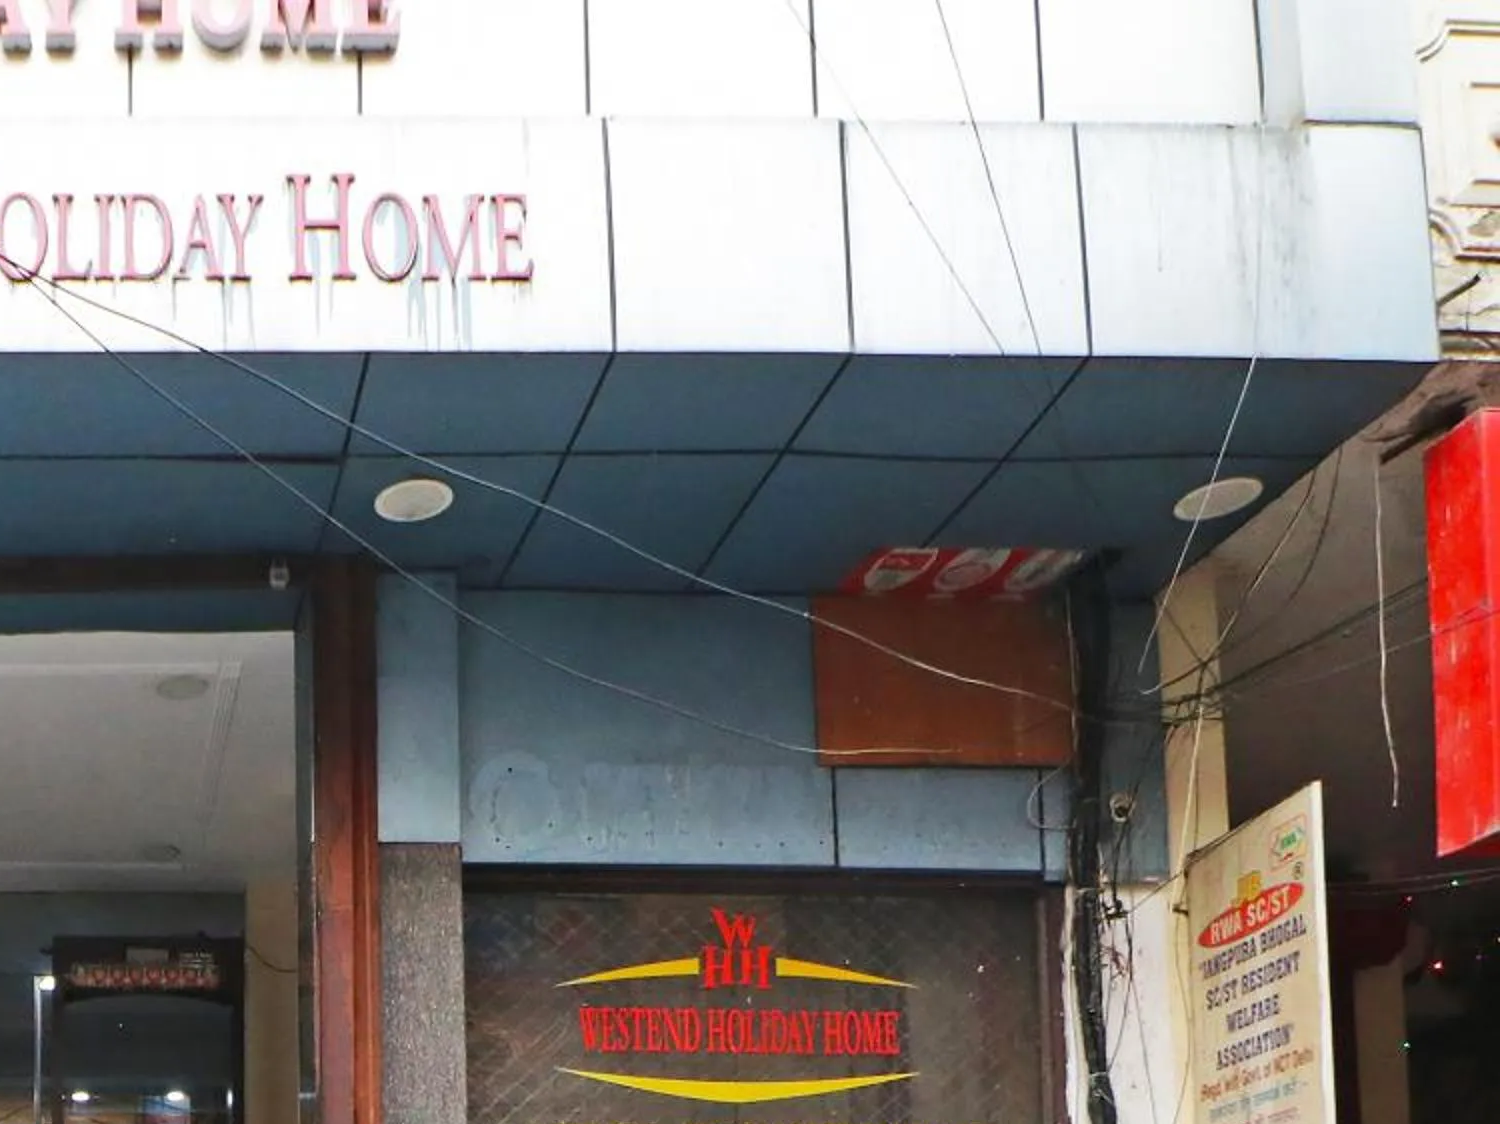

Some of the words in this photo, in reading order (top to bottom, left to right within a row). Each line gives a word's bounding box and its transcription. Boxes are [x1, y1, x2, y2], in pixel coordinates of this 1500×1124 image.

[285, 172, 534, 283] HOME
[1246, 884, 1292, 928] SC/ST
[1241, 950, 1300, 996] RESIDENT
[579, 1006, 702, 1054] WESTEND
[707, 1007, 818, 1056] HOLIDAY
[821, 1010, 901, 1057] HOME
[1226, 993, 1280, 1033] WELFARE
